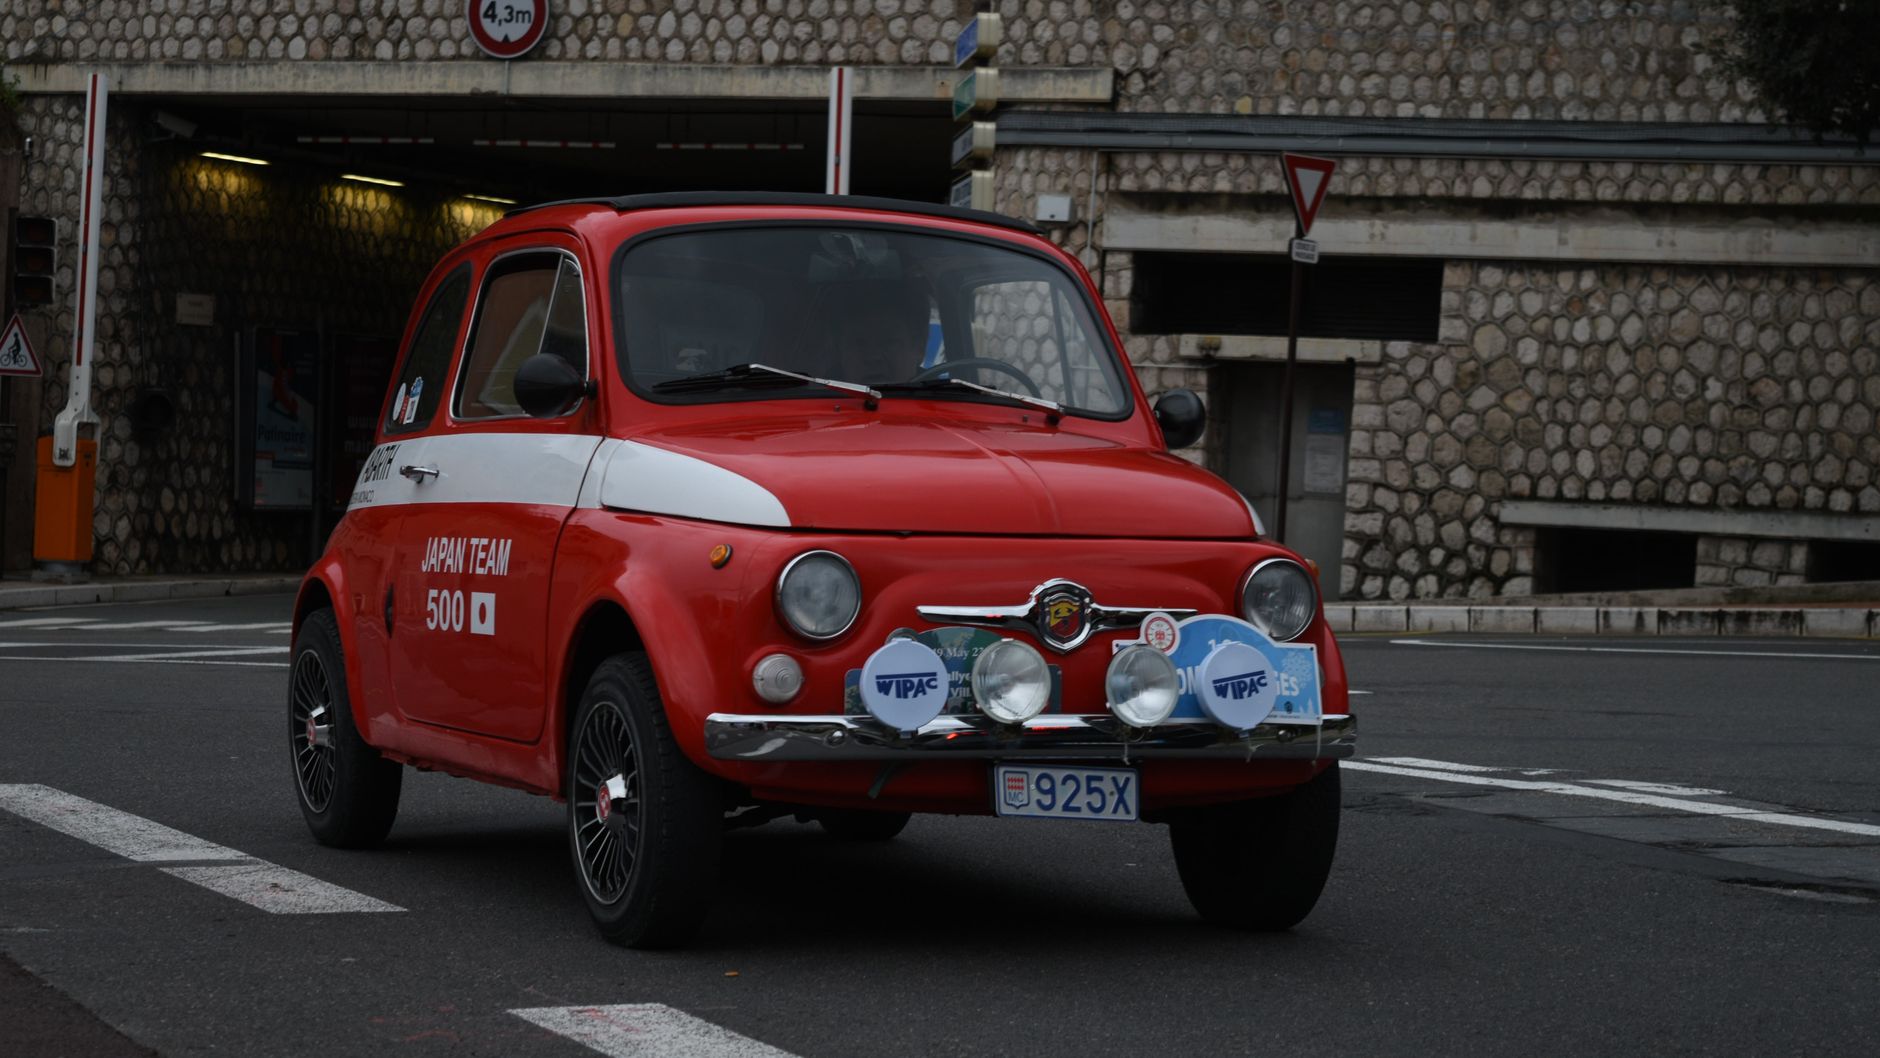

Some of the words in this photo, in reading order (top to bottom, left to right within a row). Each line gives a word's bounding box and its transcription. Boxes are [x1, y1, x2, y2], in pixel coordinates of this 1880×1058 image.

[483, 1, 532, 26] 4,3m
[421, 536, 468, 574] JAPAN
[468, 537, 512, 576] TEAM
[426, 588, 465, 632] 500
[875, 676, 938, 699] WIPAC
[1212, 674, 1268, 700] WIPAC
[1035, 772, 1132, 815] 925X
